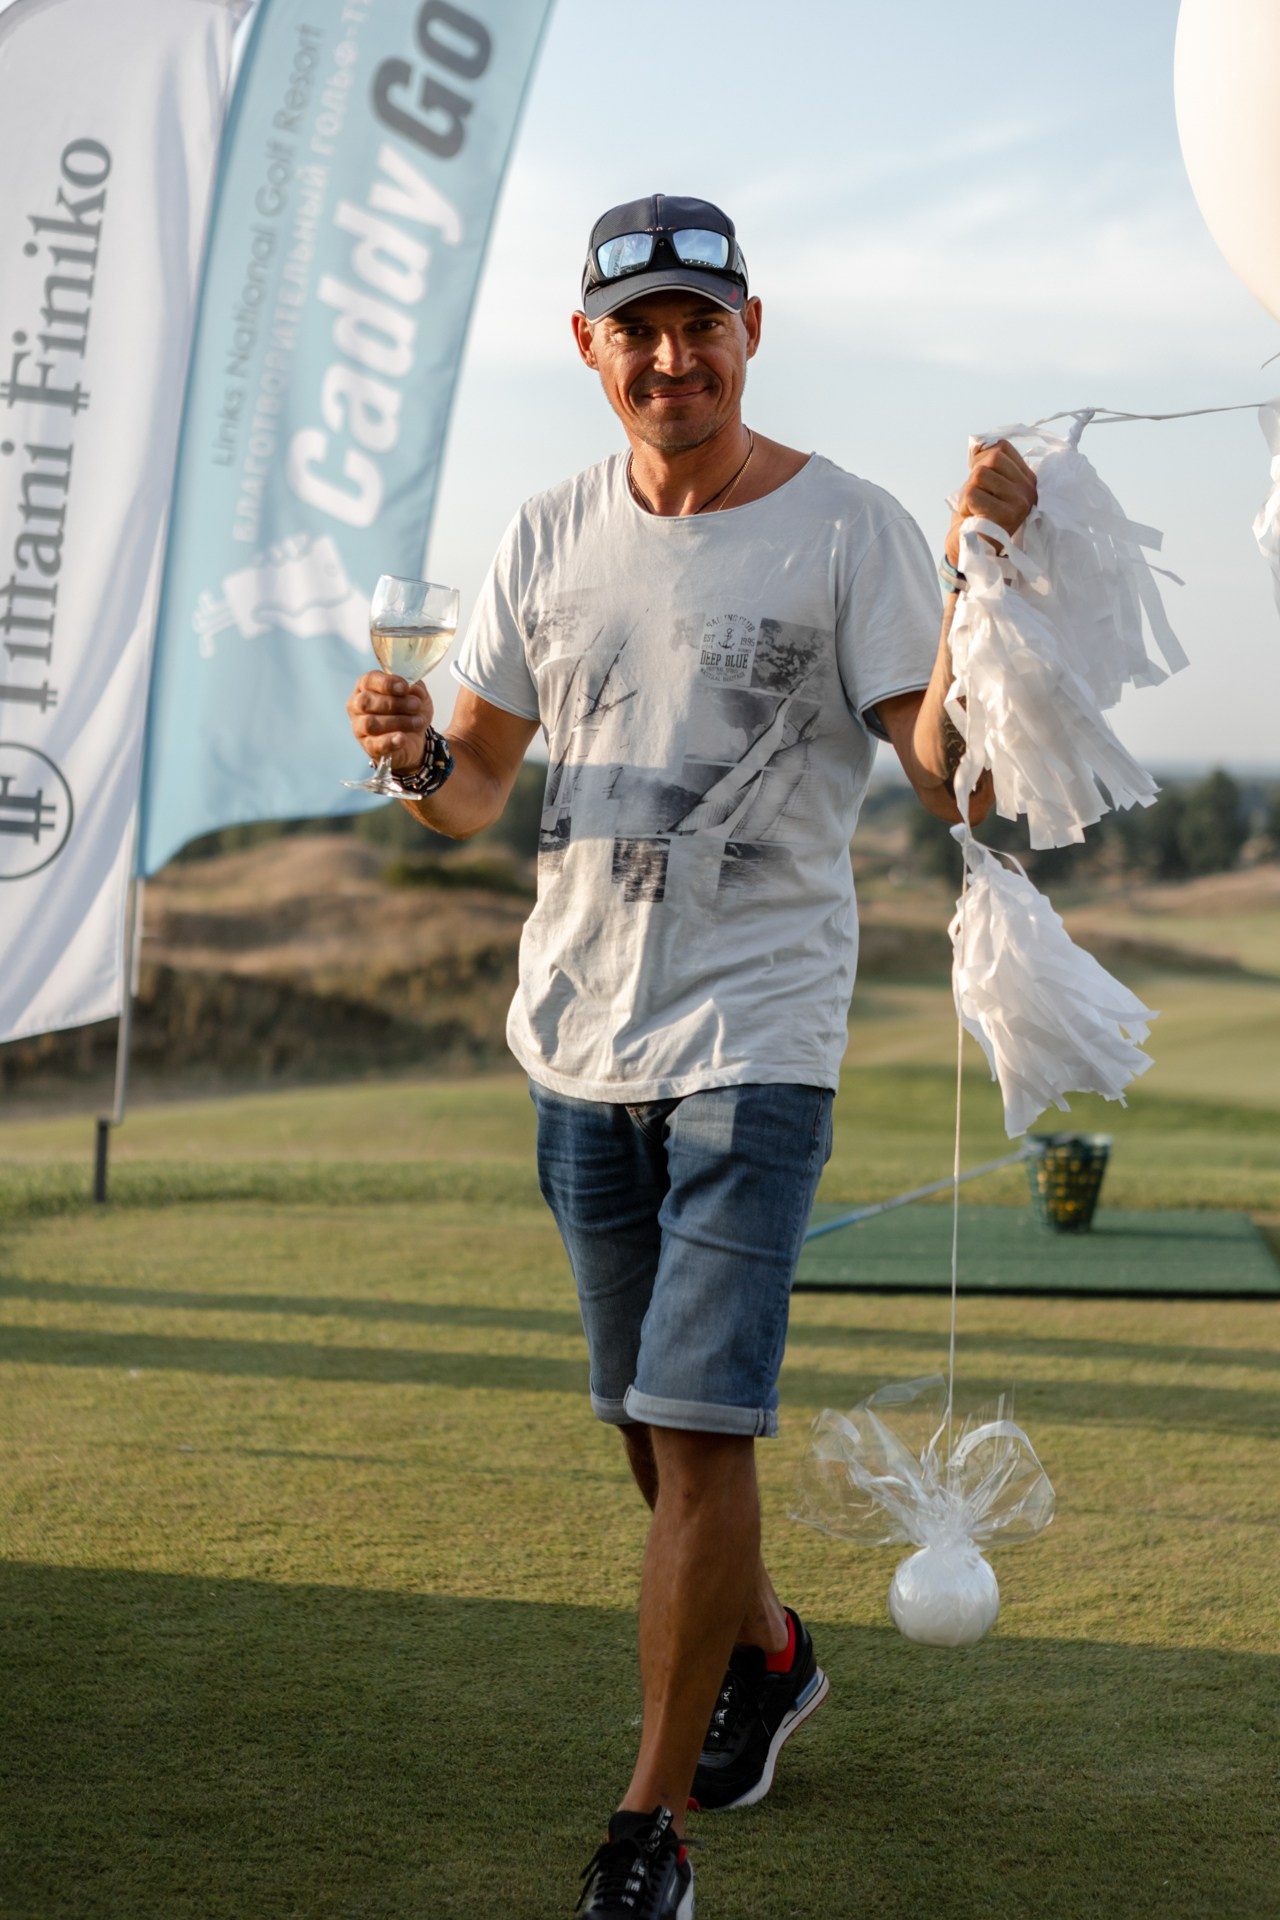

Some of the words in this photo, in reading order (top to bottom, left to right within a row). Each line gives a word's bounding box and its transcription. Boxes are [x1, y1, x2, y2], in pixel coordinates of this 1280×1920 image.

[273, 24, 325, 129] Resort
[311, 0, 370, 156] ГОЛЬФ-Т
[255, 138, 296, 215] Golf
[0, 137, 113, 417] Finiko
[233, 224, 274, 380] National
[212, 377, 246, 468] Links
[700, 650, 722, 666] DEEP
[725, 653, 749, 670] BLUE
[703, 634, 716, 643] EST
[706, 614, 738, 628] SAIING
[738, 615, 756, 633] CLUB
